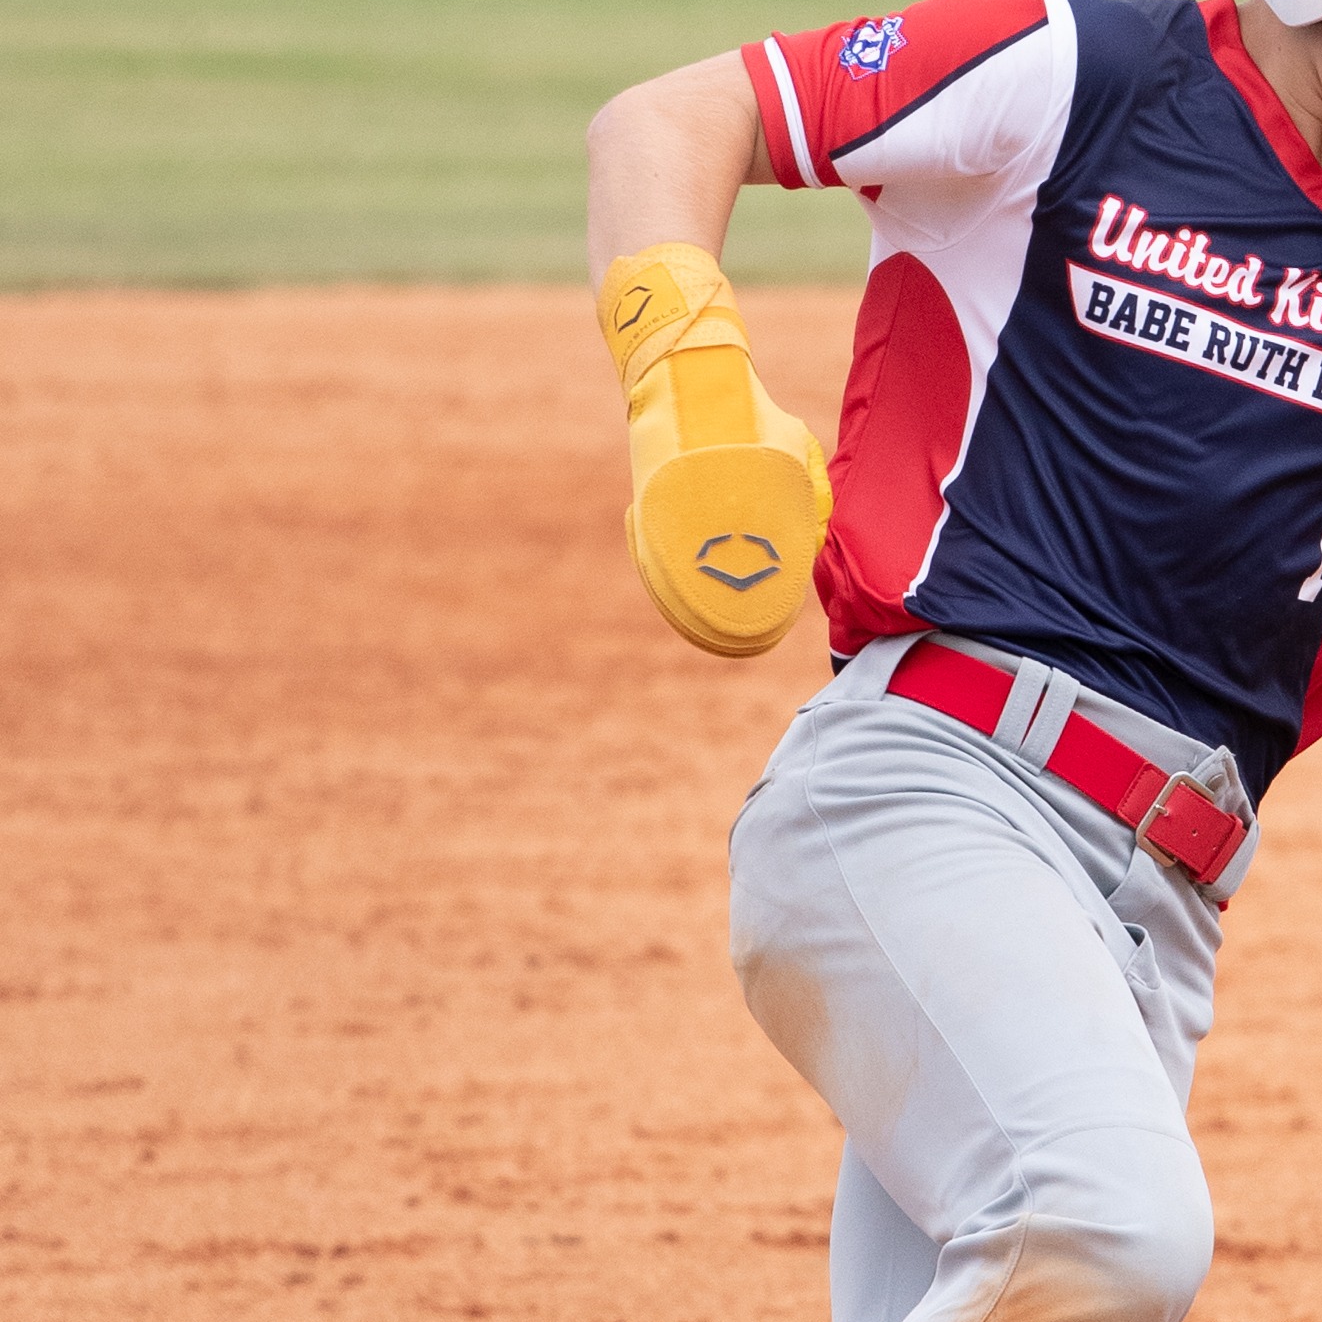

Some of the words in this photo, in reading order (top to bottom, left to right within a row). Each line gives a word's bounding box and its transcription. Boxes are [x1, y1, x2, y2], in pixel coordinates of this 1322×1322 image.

[1089, 194, 1264, 308] United
[1085, 281, 1198, 352] BABE
[1202, 321, 1310, 392] RUTH
